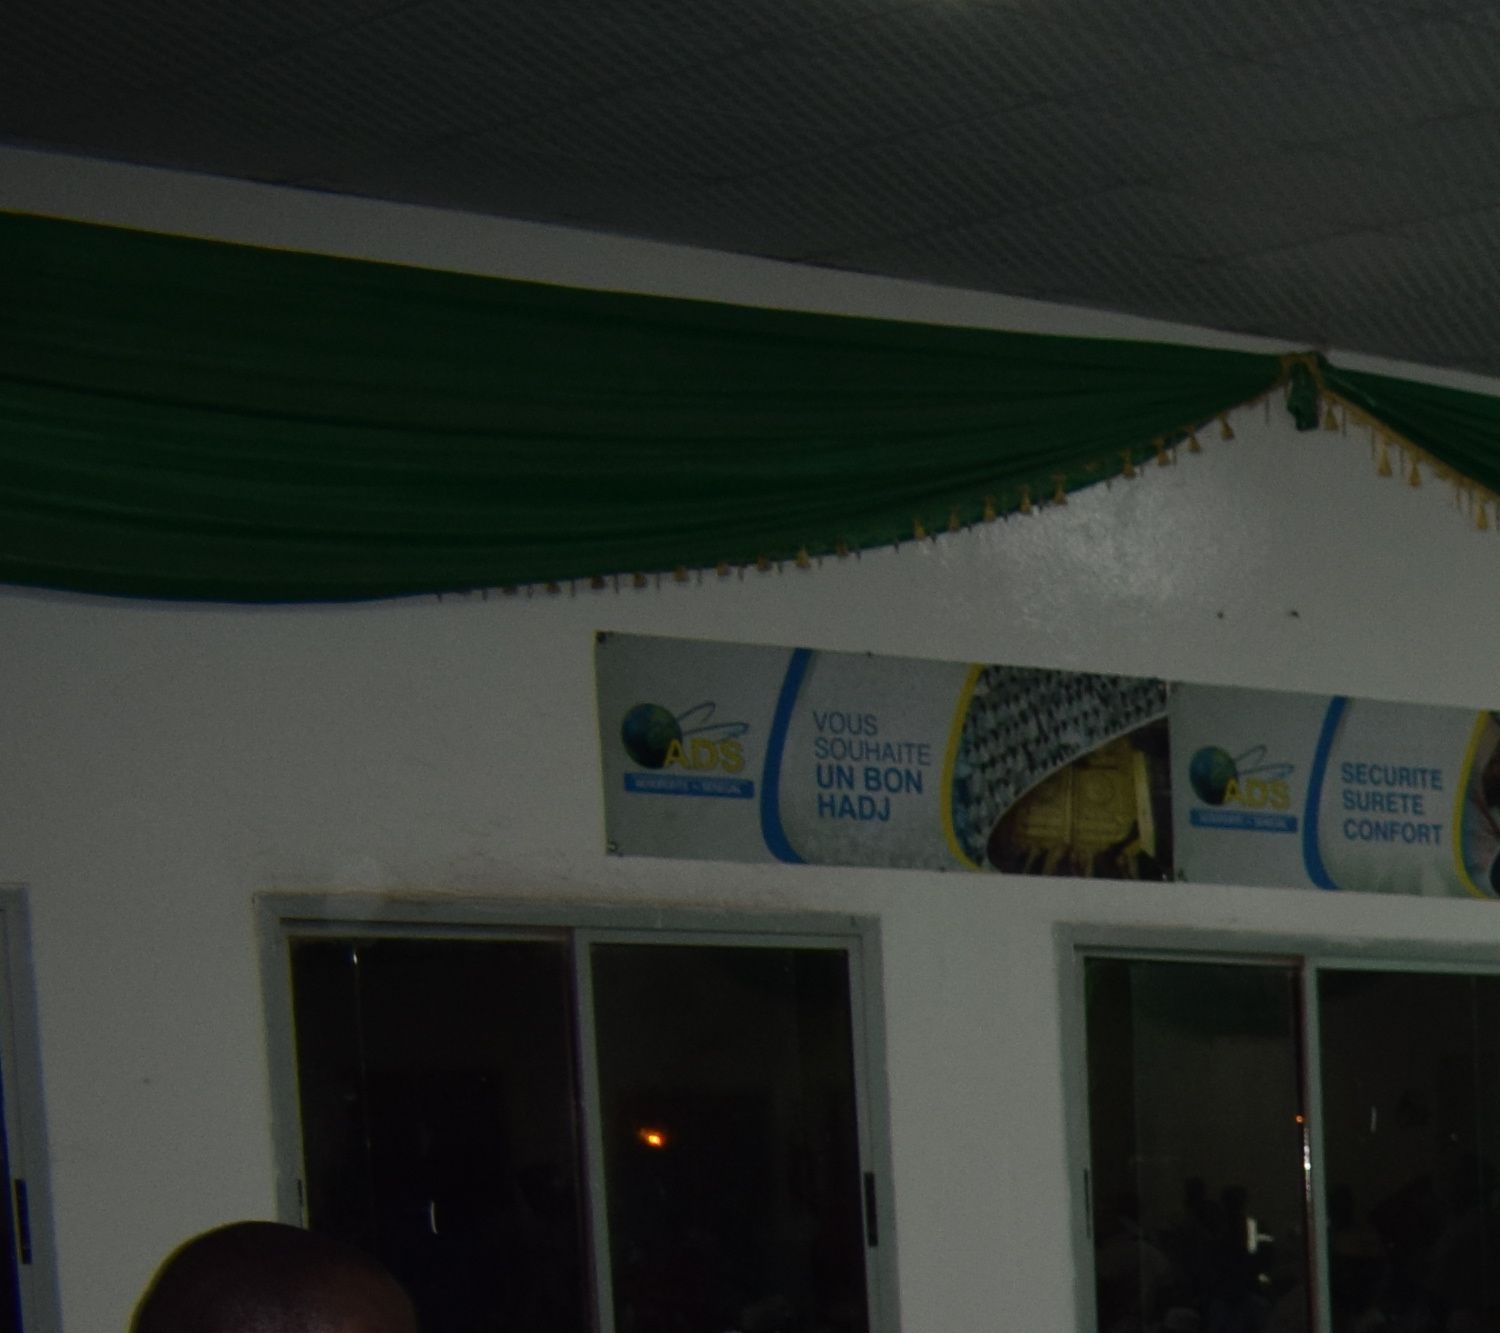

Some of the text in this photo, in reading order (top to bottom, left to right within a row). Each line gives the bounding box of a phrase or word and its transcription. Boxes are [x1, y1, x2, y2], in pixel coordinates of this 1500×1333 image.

[813, 711, 878, 737] VOUS
[664, 735, 744, 772] ADS
[815, 737, 931, 765] SOUHAITE
[816, 766, 923, 794] UN BON
[1341, 762, 1443, 791] SECURITE
[1222, 774, 1291, 810] ADS
[1343, 788, 1425, 815] SURETE
[818, 794, 892, 824] HADJ
[1343, 819, 1443, 845] CONFORT
